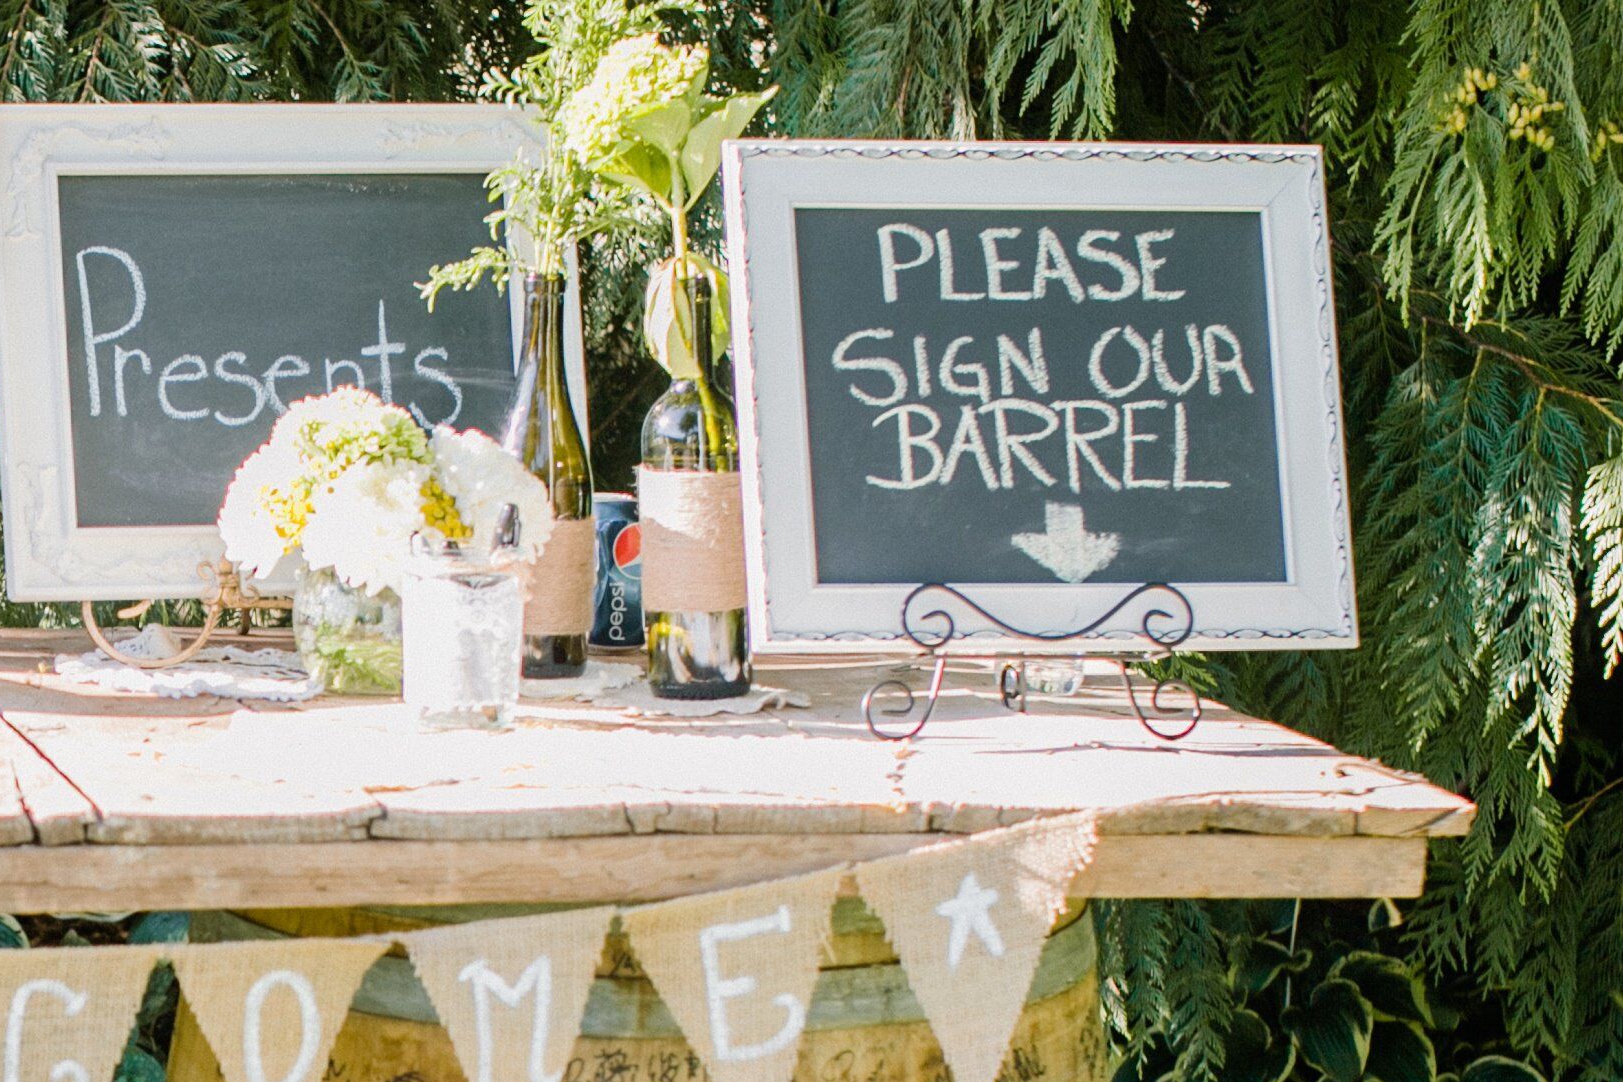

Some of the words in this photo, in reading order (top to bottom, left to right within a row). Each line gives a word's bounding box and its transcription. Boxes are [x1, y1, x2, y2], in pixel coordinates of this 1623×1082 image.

[877, 223, 1186, 304] PLEASE
[76, 245, 463, 430] Presents
[831, 327, 1050, 407] SIGN
[1087, 322, 1254, 400] OUR
[865, 398, 1231, 493] BARREL
[607, 582, 627, 641] pepsi
